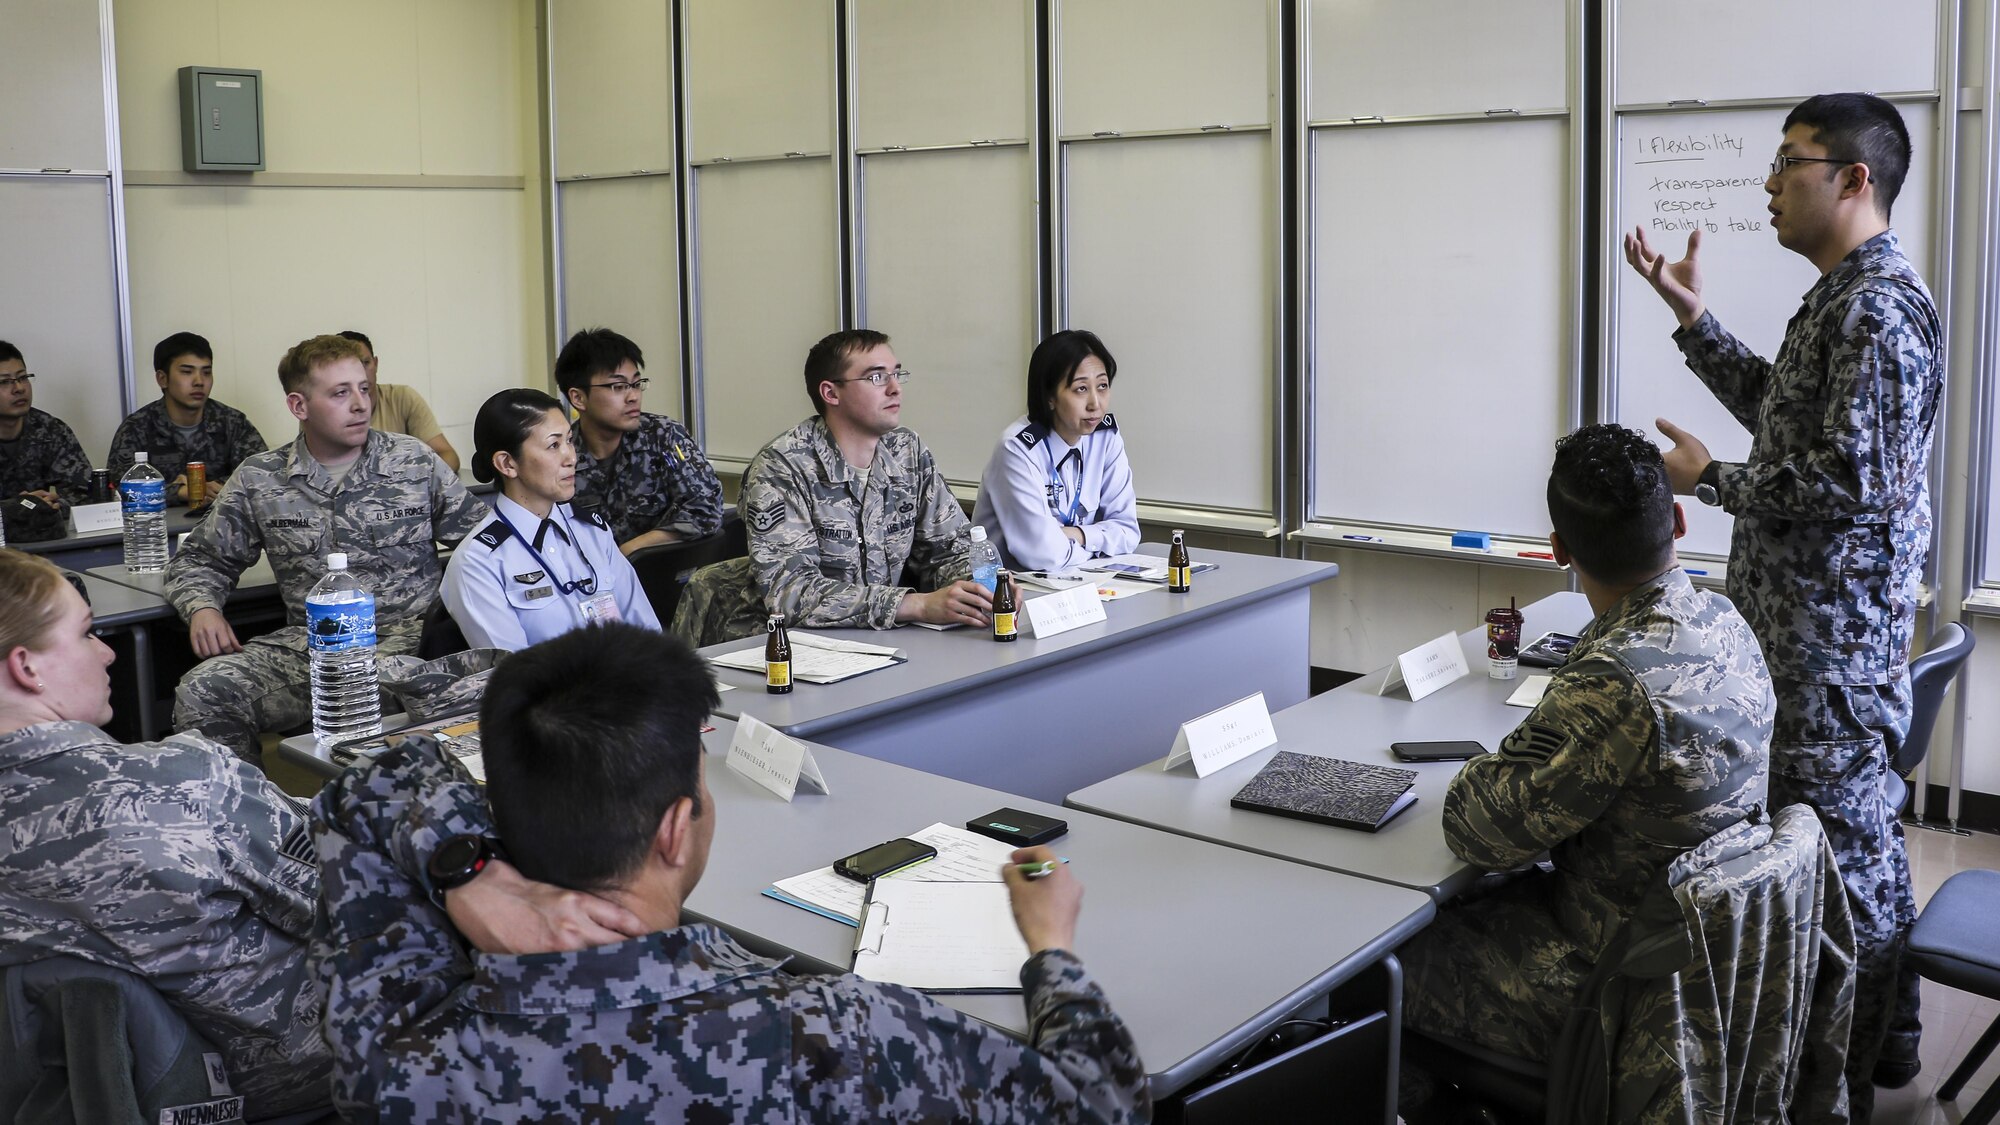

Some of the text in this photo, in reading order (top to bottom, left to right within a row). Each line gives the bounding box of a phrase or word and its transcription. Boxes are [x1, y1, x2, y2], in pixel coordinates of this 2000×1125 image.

[1654, 197, 1718, 214] respect
[1705, 217, 1718, 233] to
[1727, 216, 1762, 232] take
[392, 509, 404, 519] AIR
[404, 506, 425, 517] FORCE
